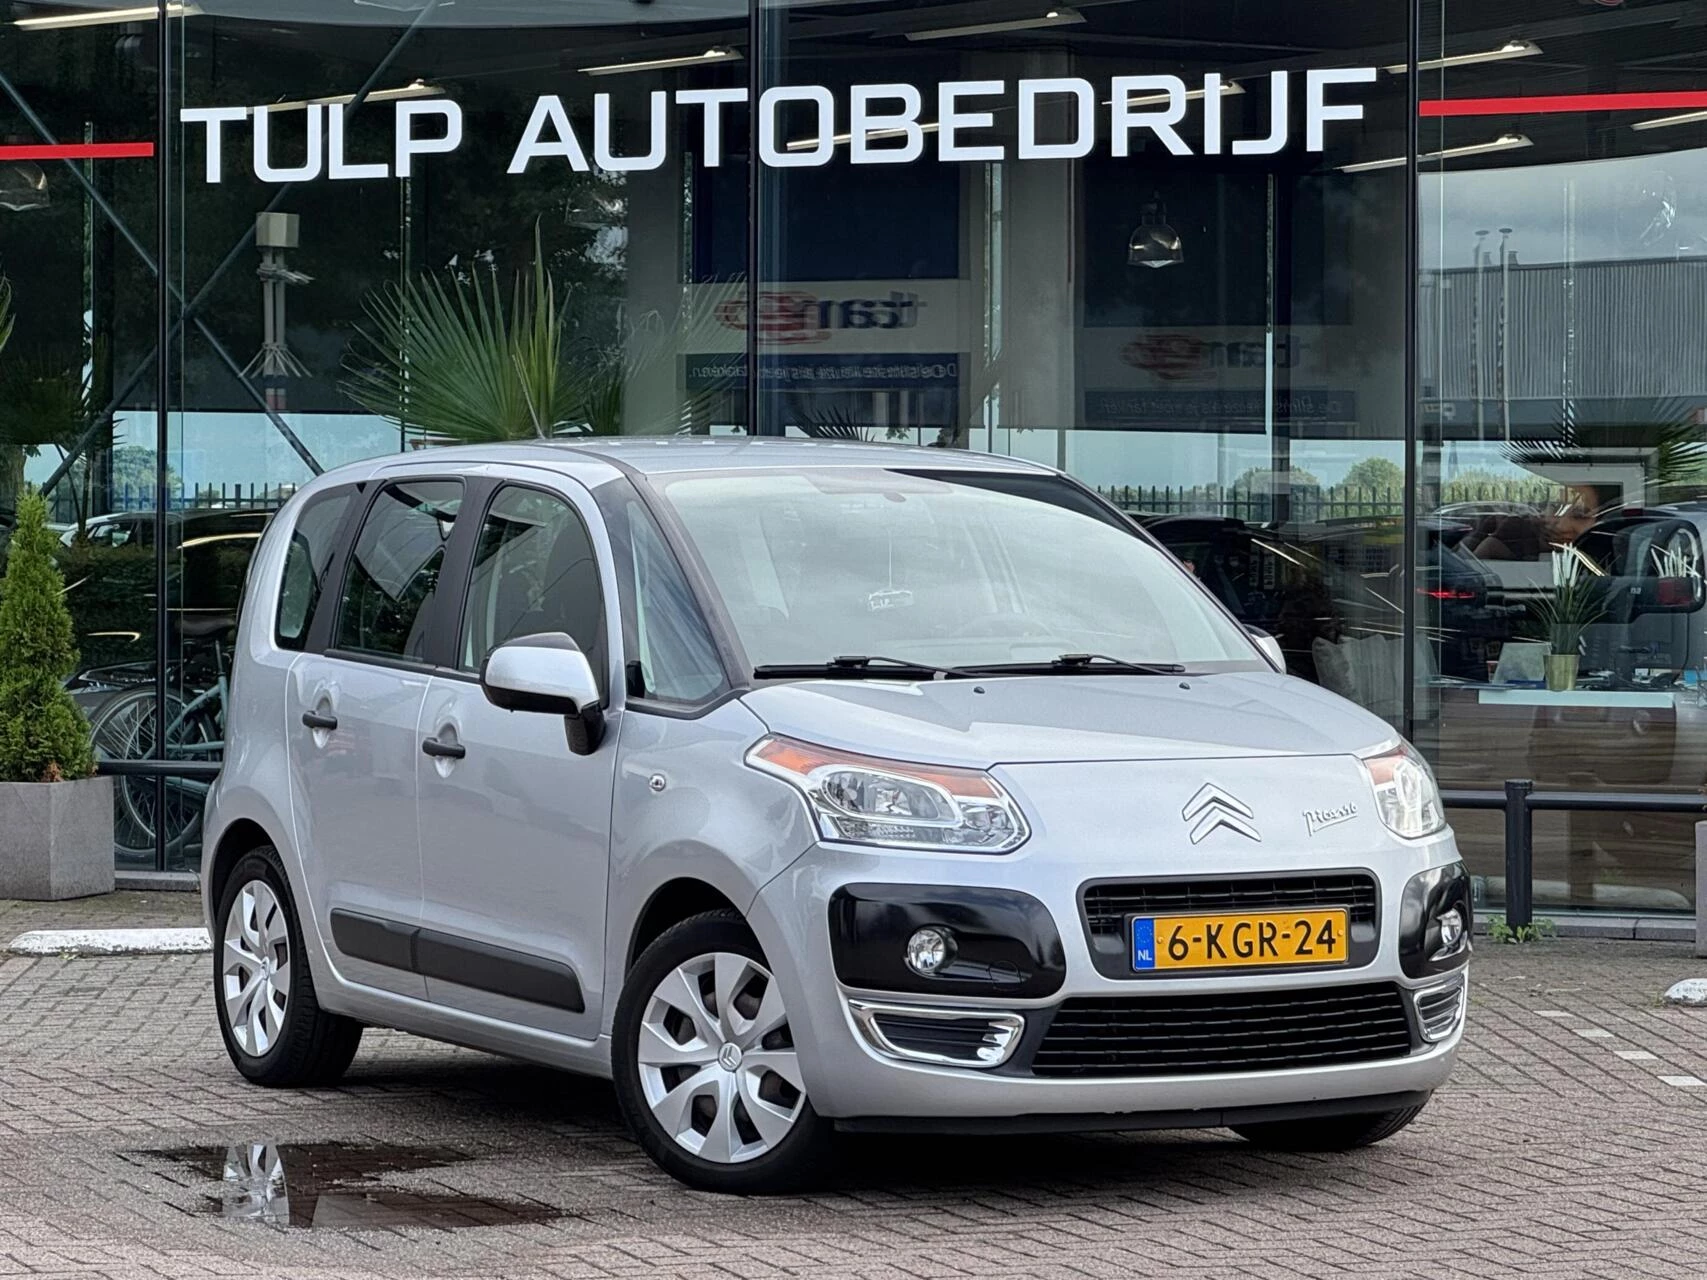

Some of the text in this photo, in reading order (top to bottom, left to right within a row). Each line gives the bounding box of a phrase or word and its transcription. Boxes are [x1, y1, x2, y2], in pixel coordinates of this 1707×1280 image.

[180, 67, 1378, 184] TULP AUTOBEDRIJF
[1137, 919, 1337, 961] NL 6-KGR-24
